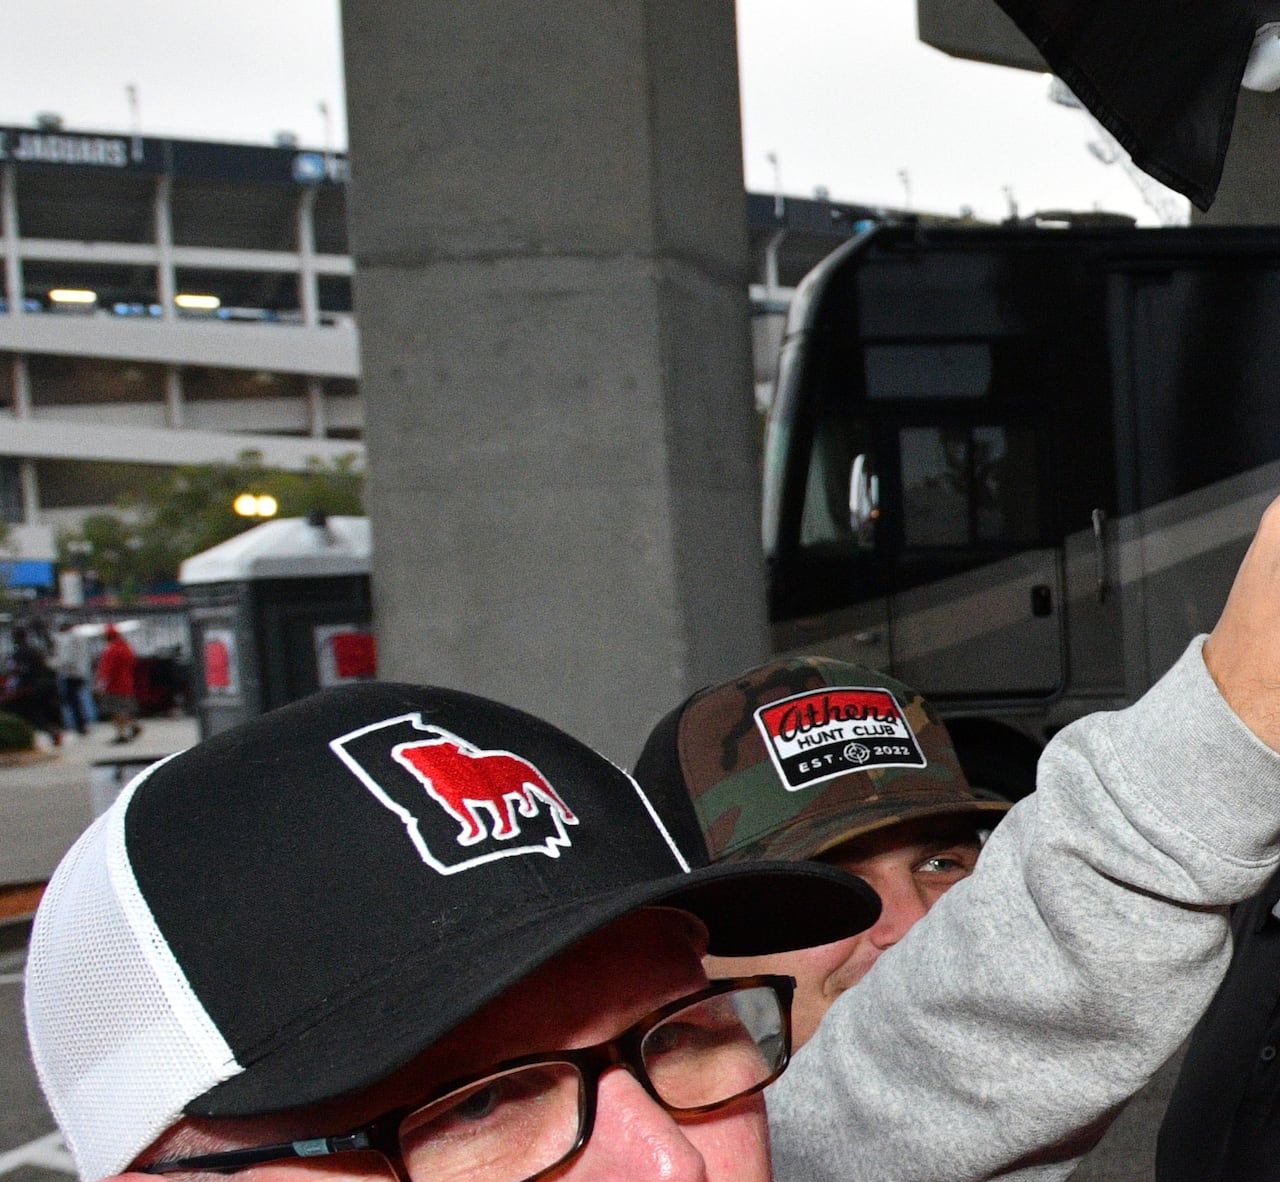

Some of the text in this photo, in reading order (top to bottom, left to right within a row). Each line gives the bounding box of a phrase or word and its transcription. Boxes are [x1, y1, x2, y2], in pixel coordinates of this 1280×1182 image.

[779, 697, 898, 742] Athens
[797, 725, 896, 750] HUNT CLUB
[799, 745, 911, 774] EST. 2022
